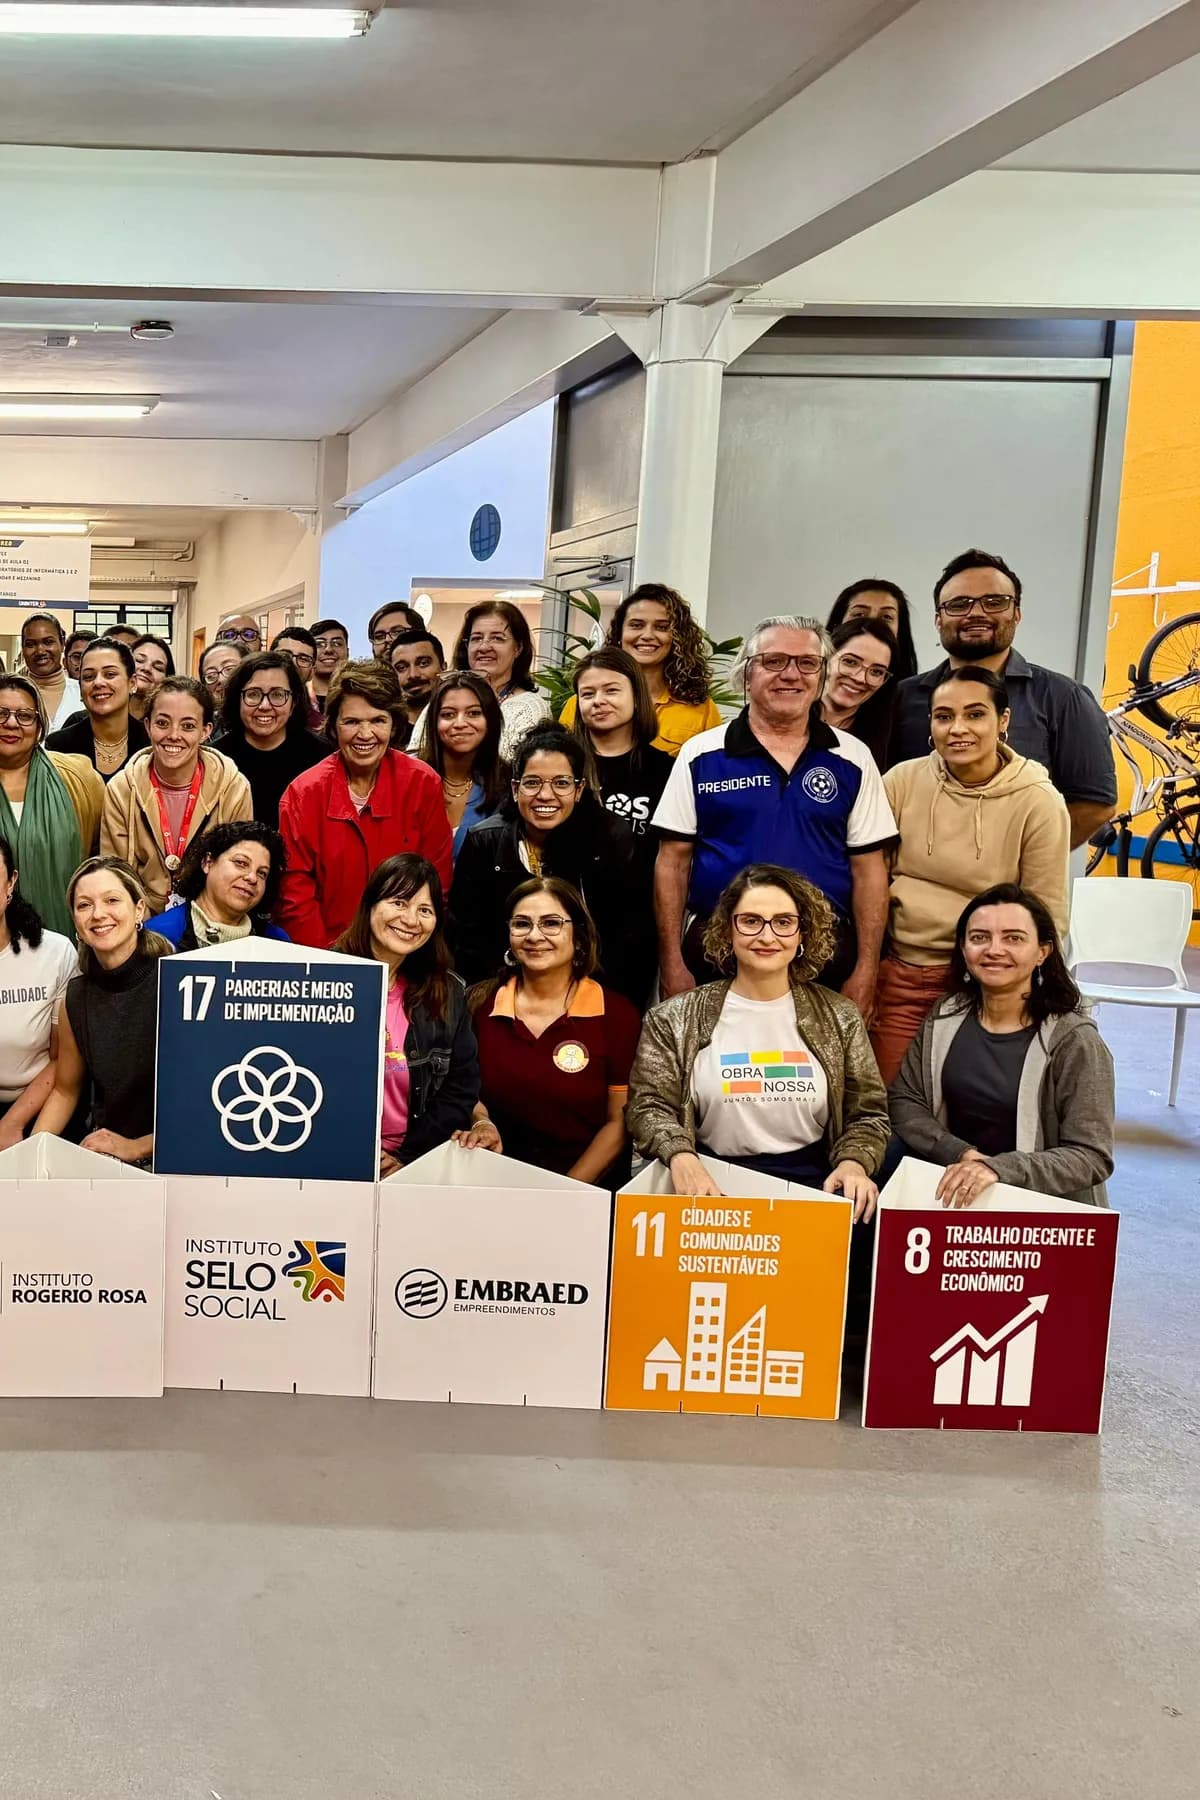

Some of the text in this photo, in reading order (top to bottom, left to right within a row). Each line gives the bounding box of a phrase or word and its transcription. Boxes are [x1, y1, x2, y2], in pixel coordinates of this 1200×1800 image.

[697, 775, 772, 795] PRESIDENTE
[178, 975, 216, 1021] 17
[225, 979, 353, 1000] PARCERIAS E MEIOS
[224, 1002, 355, 1024] DE IMPLEMENTAÇÃO
[721, 1067, 763, 1079] OBRA
[764, 1081, 816, 1093] NOSSA
[723, 1096, 757, 1104] JUNTOS
[681, 1207, 752, 1228] CIDADES E
[631, 1211, 666, 1257] 11
[679, 1231, 781, 1253] COMUNIDADES
[945, 1226, 1096, 1247] TRABALHO DECENTE E
[185, 1238, 282, 1257] INSTITUTO
[904, 1227, 931, 1275] 8
[678, 1254, 779, 1276] SUSTENTÁVEIS
[943, 1250, 1042, 1269] CRESCIMENTO
[12, 1273, 94, 1287] INSTITUTO
[185, 1259, 277, 1292] SELO
[940, 1272, 1025, 1292] ECONÔMICO
[11, 1289, 148, 1304] ROGERIO ROSA
[454, 1278, 589, 1305] EMBRAED
[184, 1294, 287, 1321] SOCIAL
[453, 1303, 557, 1317] EMPREENDIMENTOS
